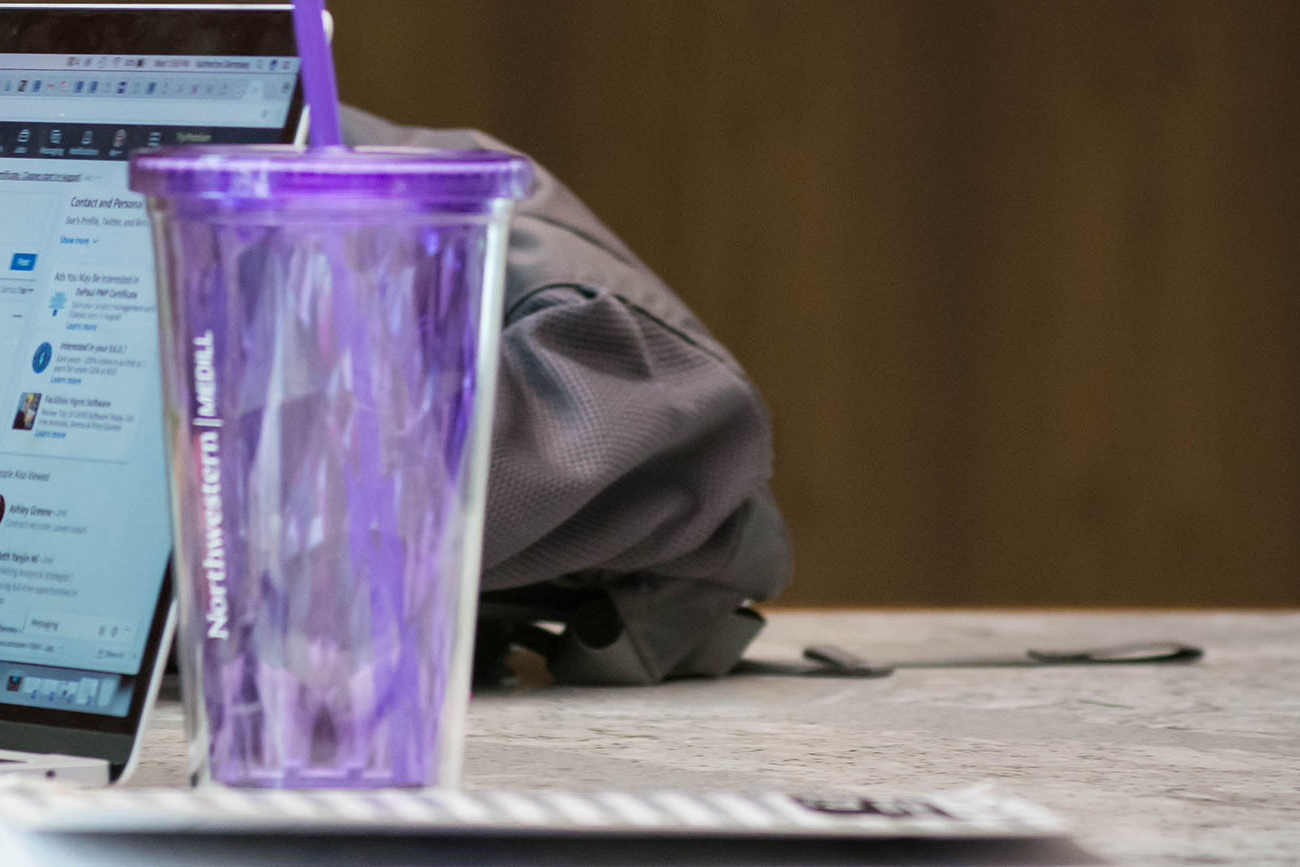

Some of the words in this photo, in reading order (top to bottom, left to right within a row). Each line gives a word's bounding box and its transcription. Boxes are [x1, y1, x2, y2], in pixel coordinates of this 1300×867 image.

[70, 197, 98, 208] Contact
[99, 197, 114, 208] and
[54, 272, 66, 281] Ads
[67, 273, 77, 282] You
[79, 274, 90, 283] May
[193, 329, 216, 417] MEDILL
[28, 470, 50, 482] Viewed
[200, 431, 228, 640] Northwestern
